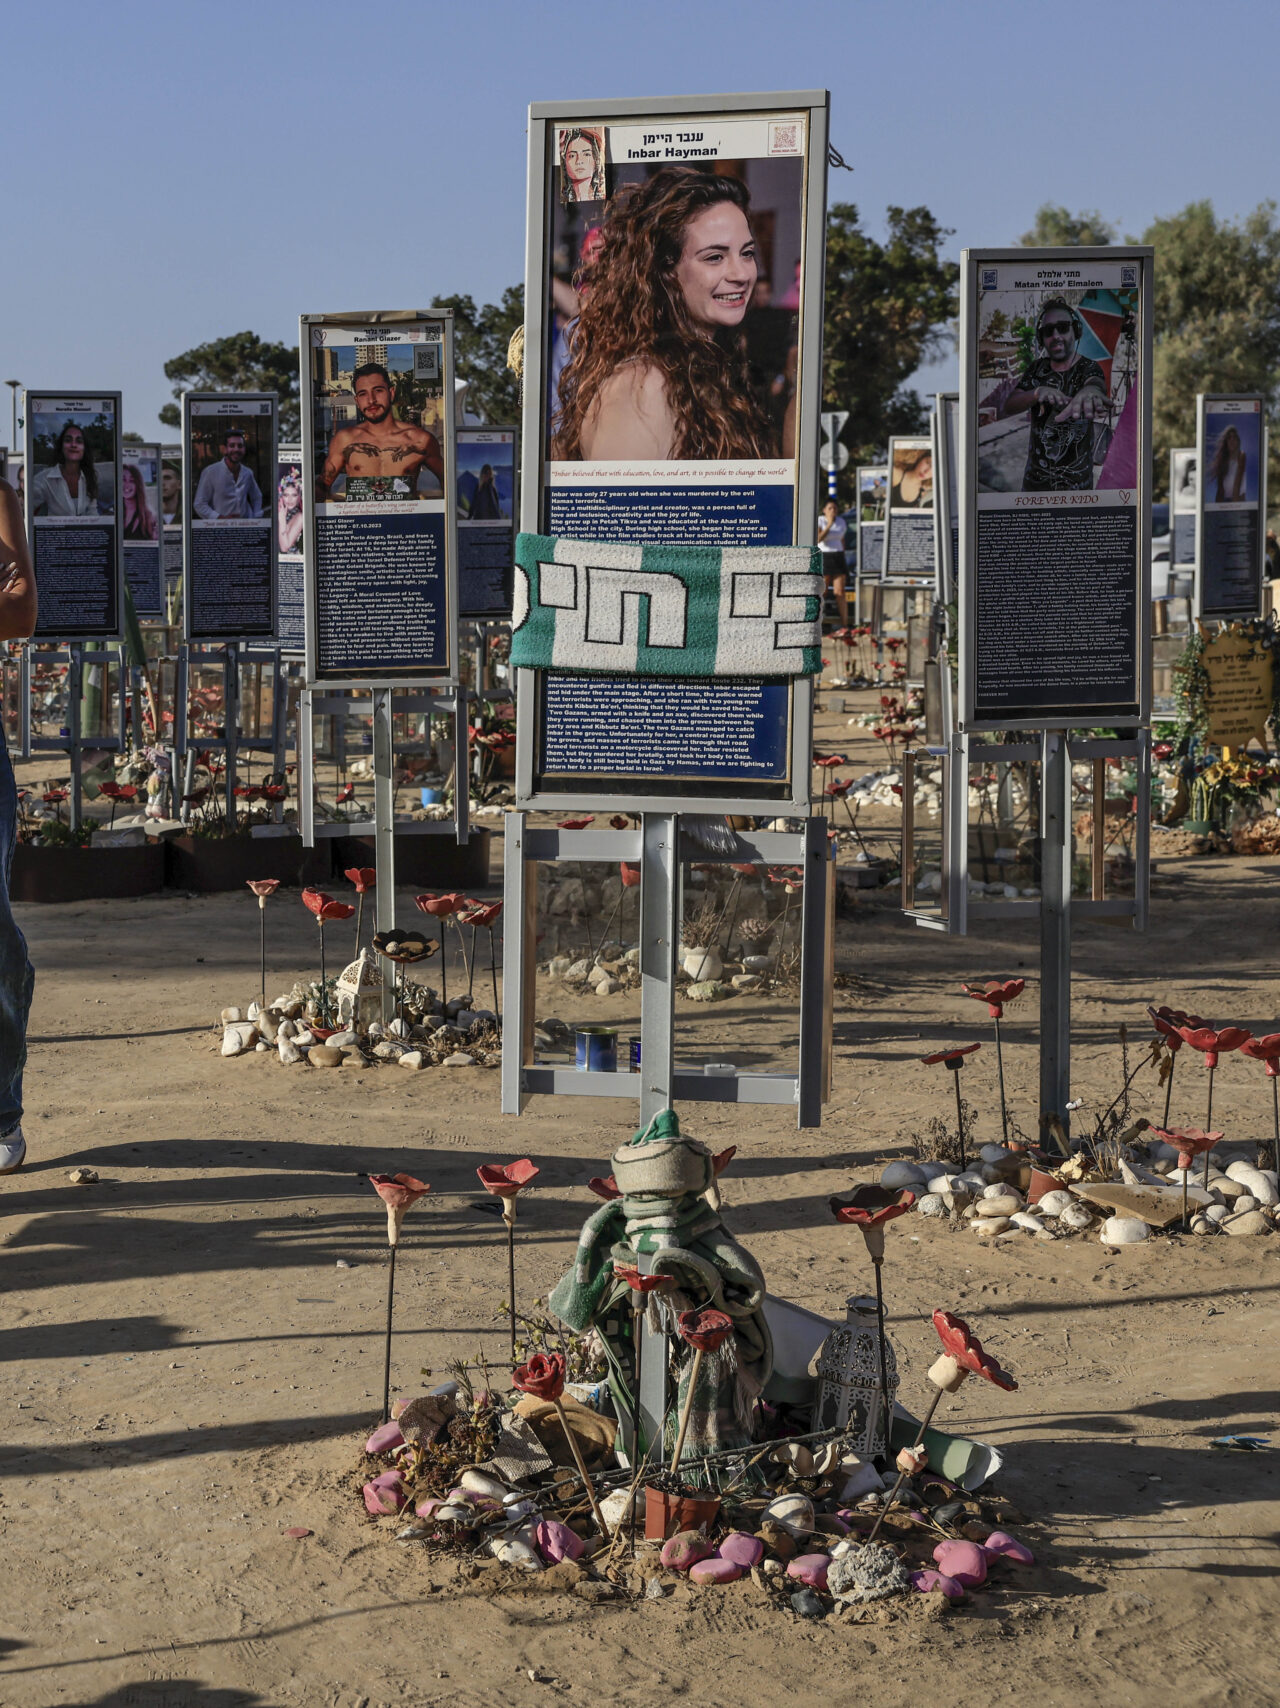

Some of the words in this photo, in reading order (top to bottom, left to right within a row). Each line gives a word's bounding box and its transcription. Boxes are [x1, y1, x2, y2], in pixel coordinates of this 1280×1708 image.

[643, 134, 672, 146] היימן
[677, 132, 704, 142] ענבר
[628, 148, 661, 158] Inbar
[665, 147, 717, 159] Hayman
[1015, 496, 1067, 506] FOREVER
[1070, 495, 1099, 504] KIDO
